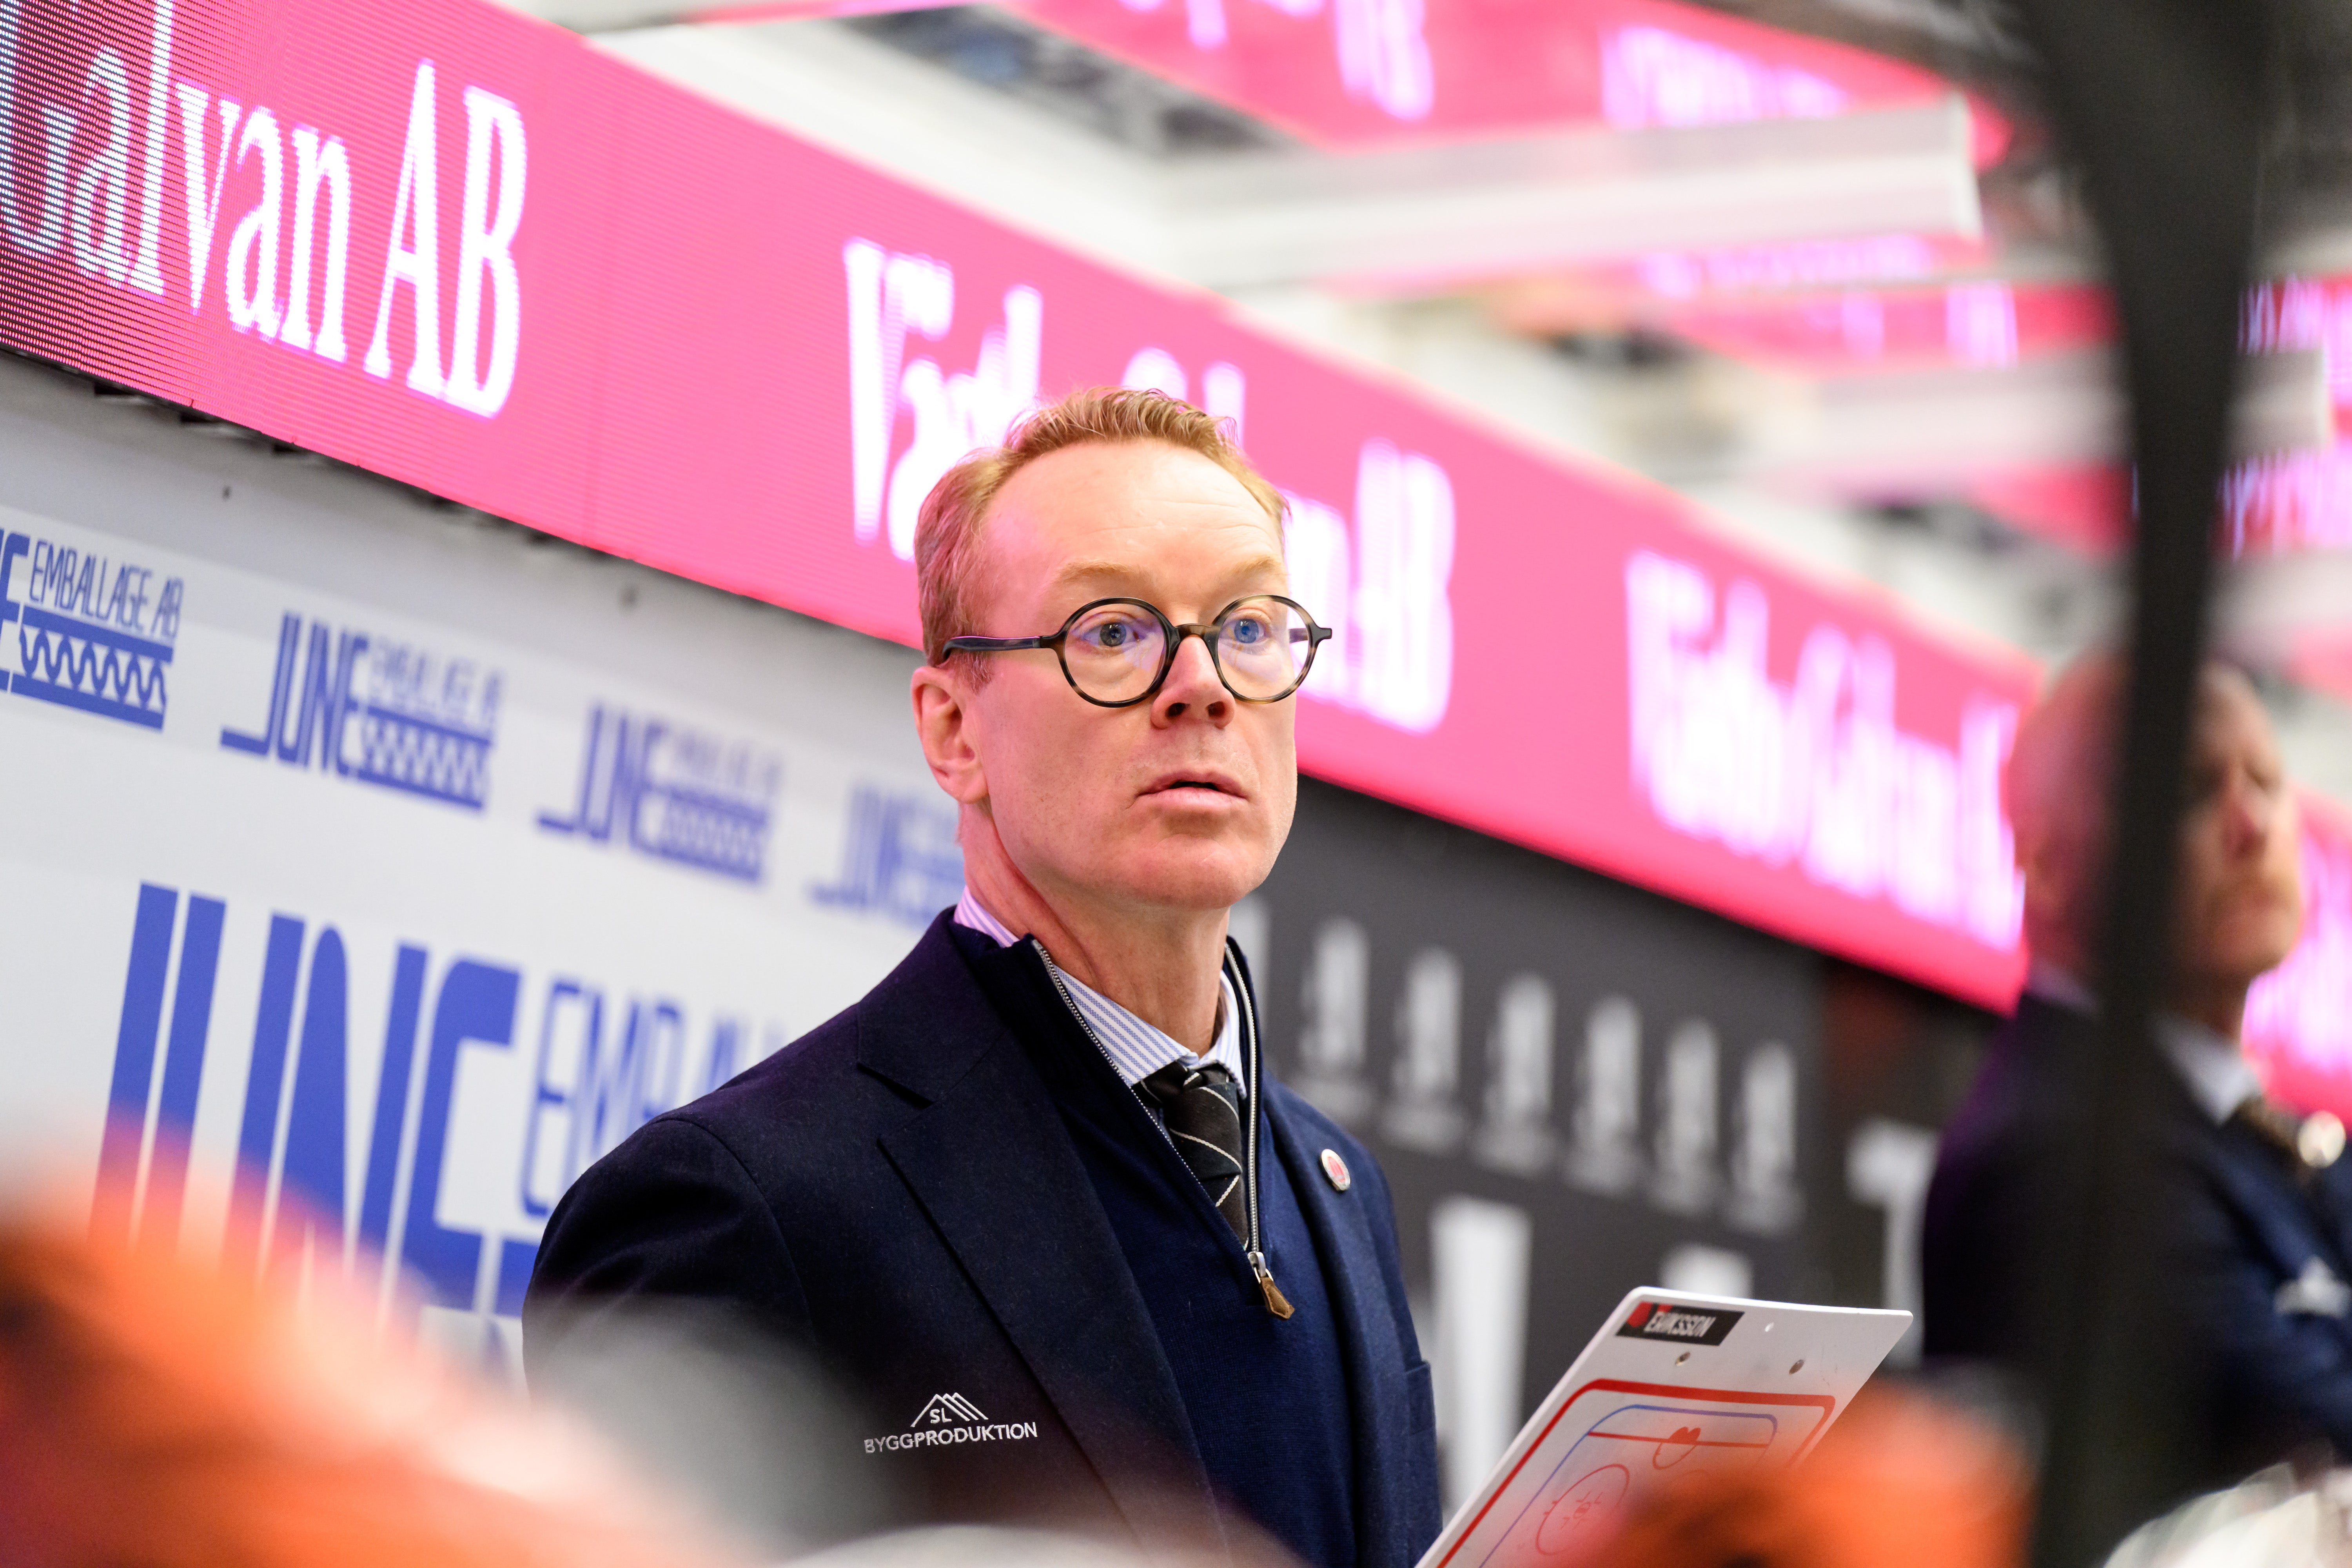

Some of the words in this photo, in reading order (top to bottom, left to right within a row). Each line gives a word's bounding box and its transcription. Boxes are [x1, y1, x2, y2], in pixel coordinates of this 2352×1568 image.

[363, 58, 528, 419] AB
[29, 538, 154, 633] EMBALLAGE
[150, 576, 185, 640] AB
[1642, 1310, 1717, 1338] ERIKSSON
[929, 1407, 952, 1424] SL
[863, 1421, 1038, 1454] BYGGPRODUKTION
